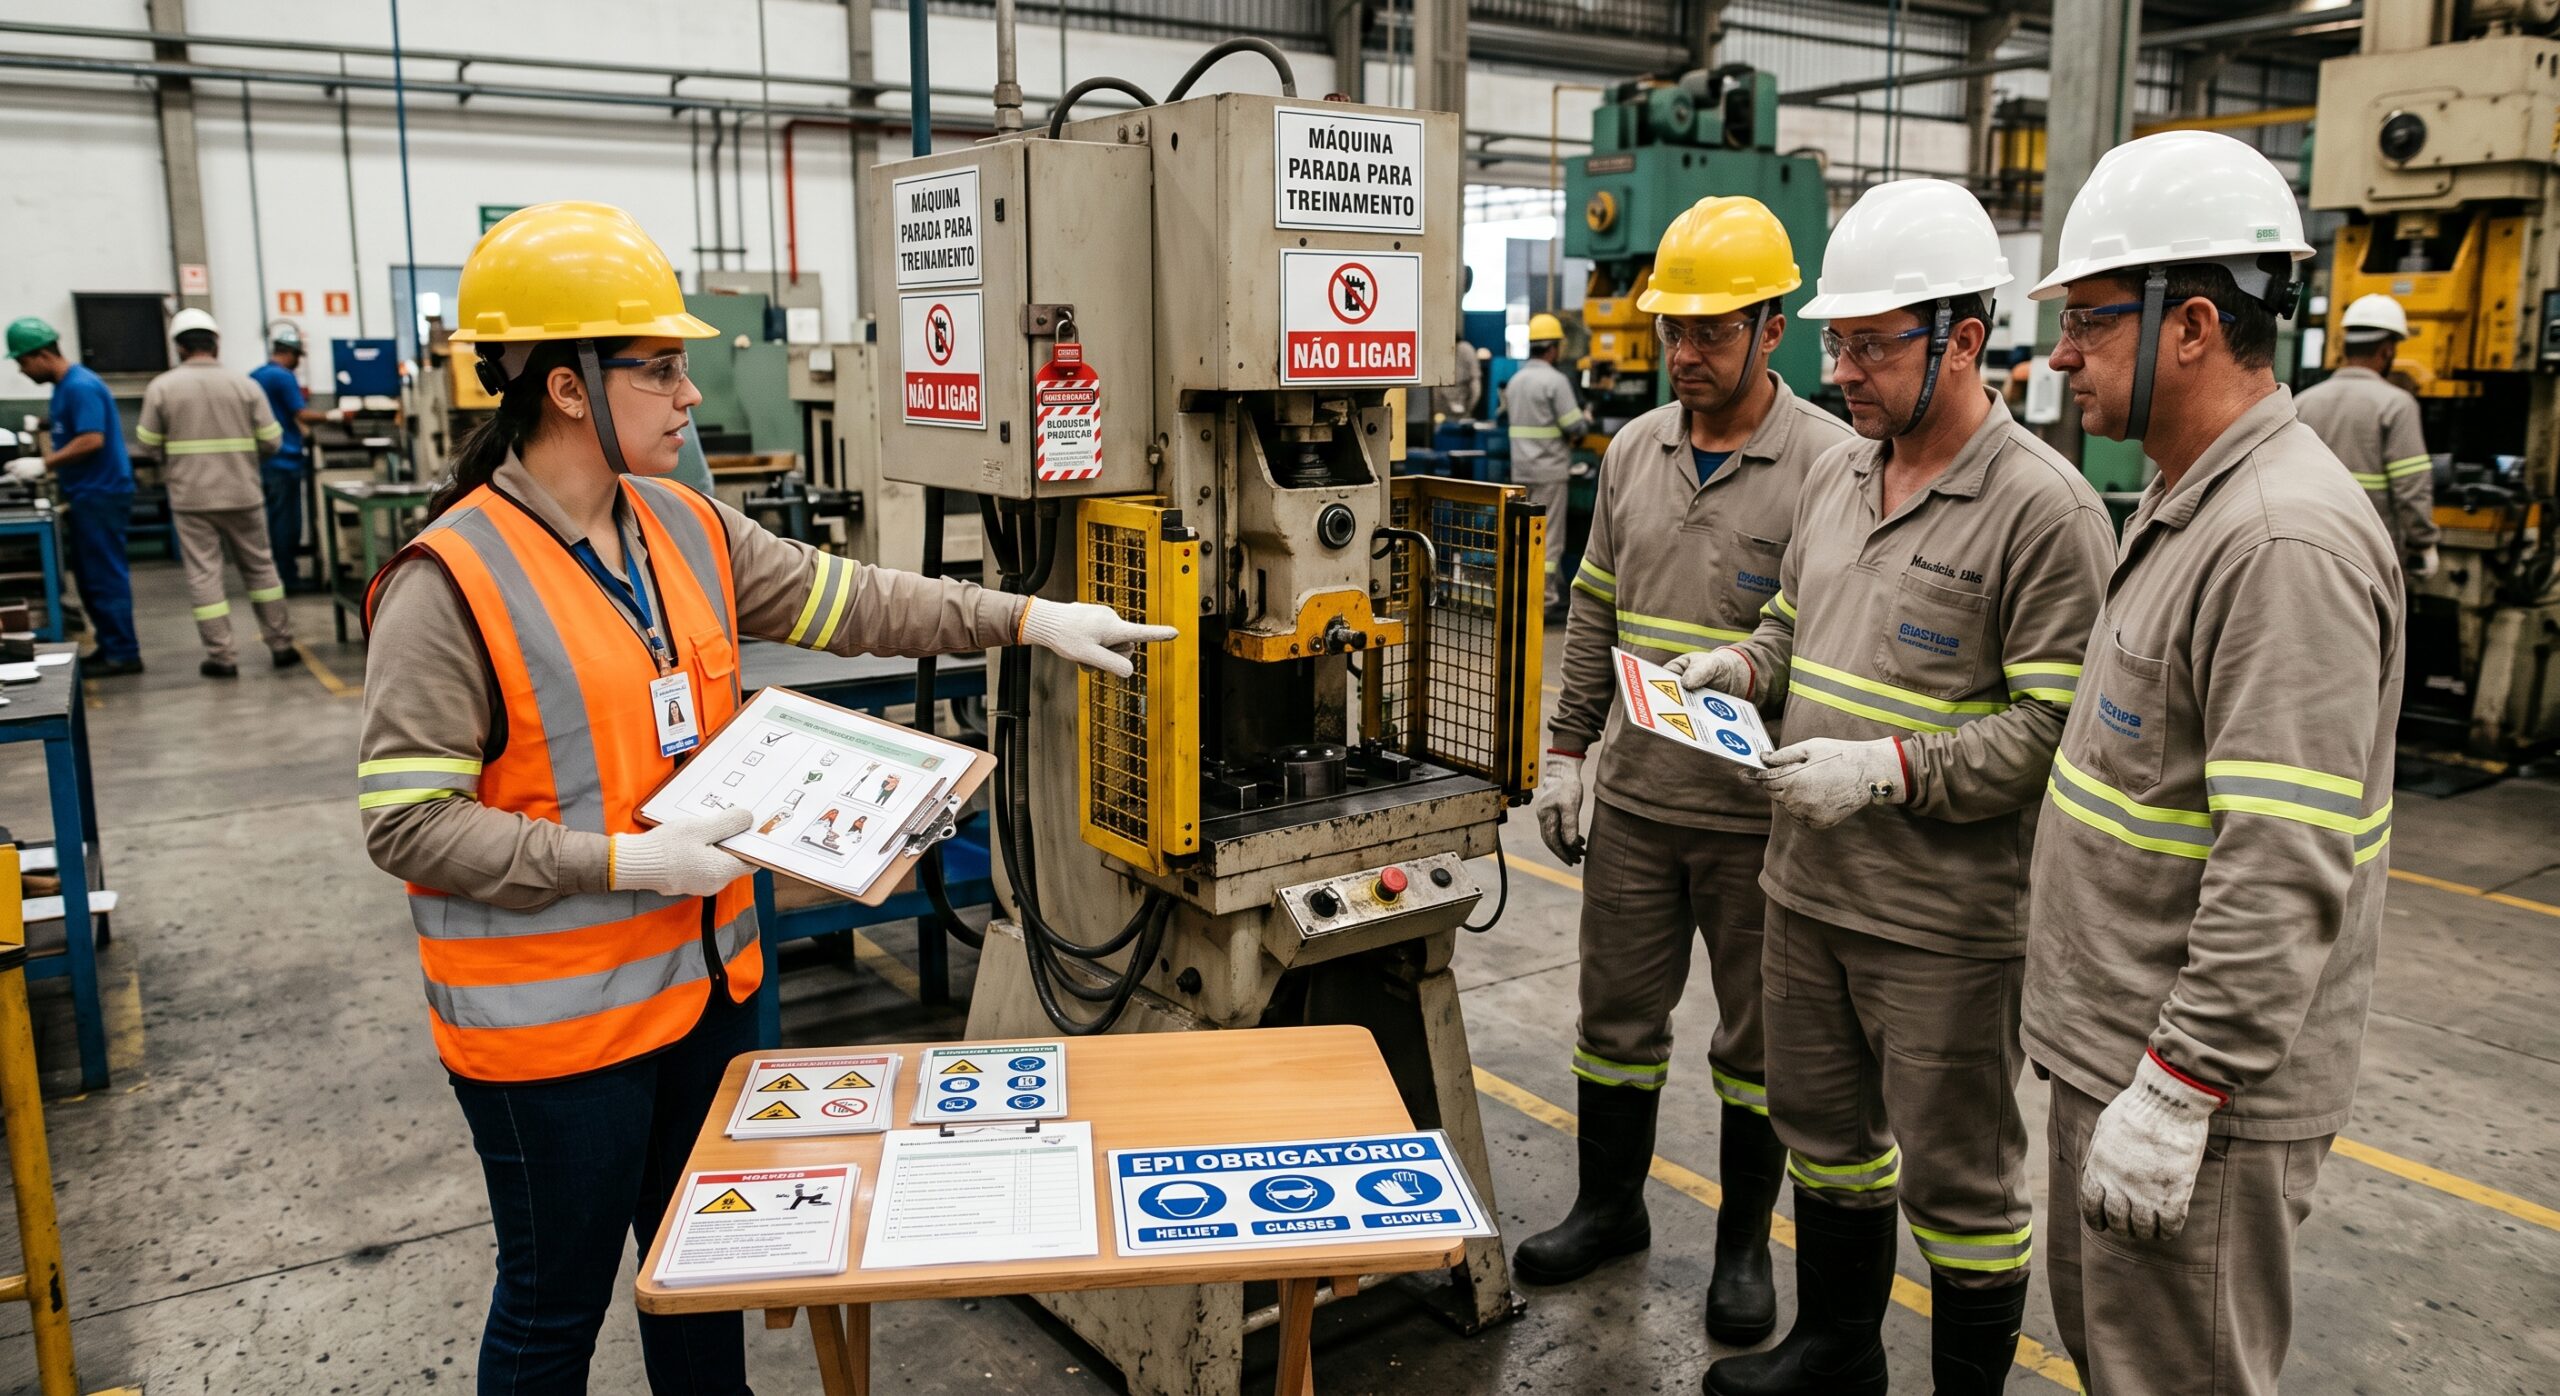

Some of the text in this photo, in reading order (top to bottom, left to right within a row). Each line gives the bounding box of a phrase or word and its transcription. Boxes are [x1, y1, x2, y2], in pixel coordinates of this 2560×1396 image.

[1309, 125, 1393, 154] MÁQUINA
[1289, 158, 1412, 186] PARADA PARA
[911, 187, 961, 214] MÁQUINA
[1287, 189, 1414, 217] TREINAMENTO
[901, 215, 973, 243] PARADA PARA
[901, 245, 974, 272] TREINAMENTO
[1293, 337, 1411, 369] NÃO LIGAR
[937, 384, 978, 413] LIGAR
[1132, 1141, 1427, 1174] EPI OBRIGATÓRIO
